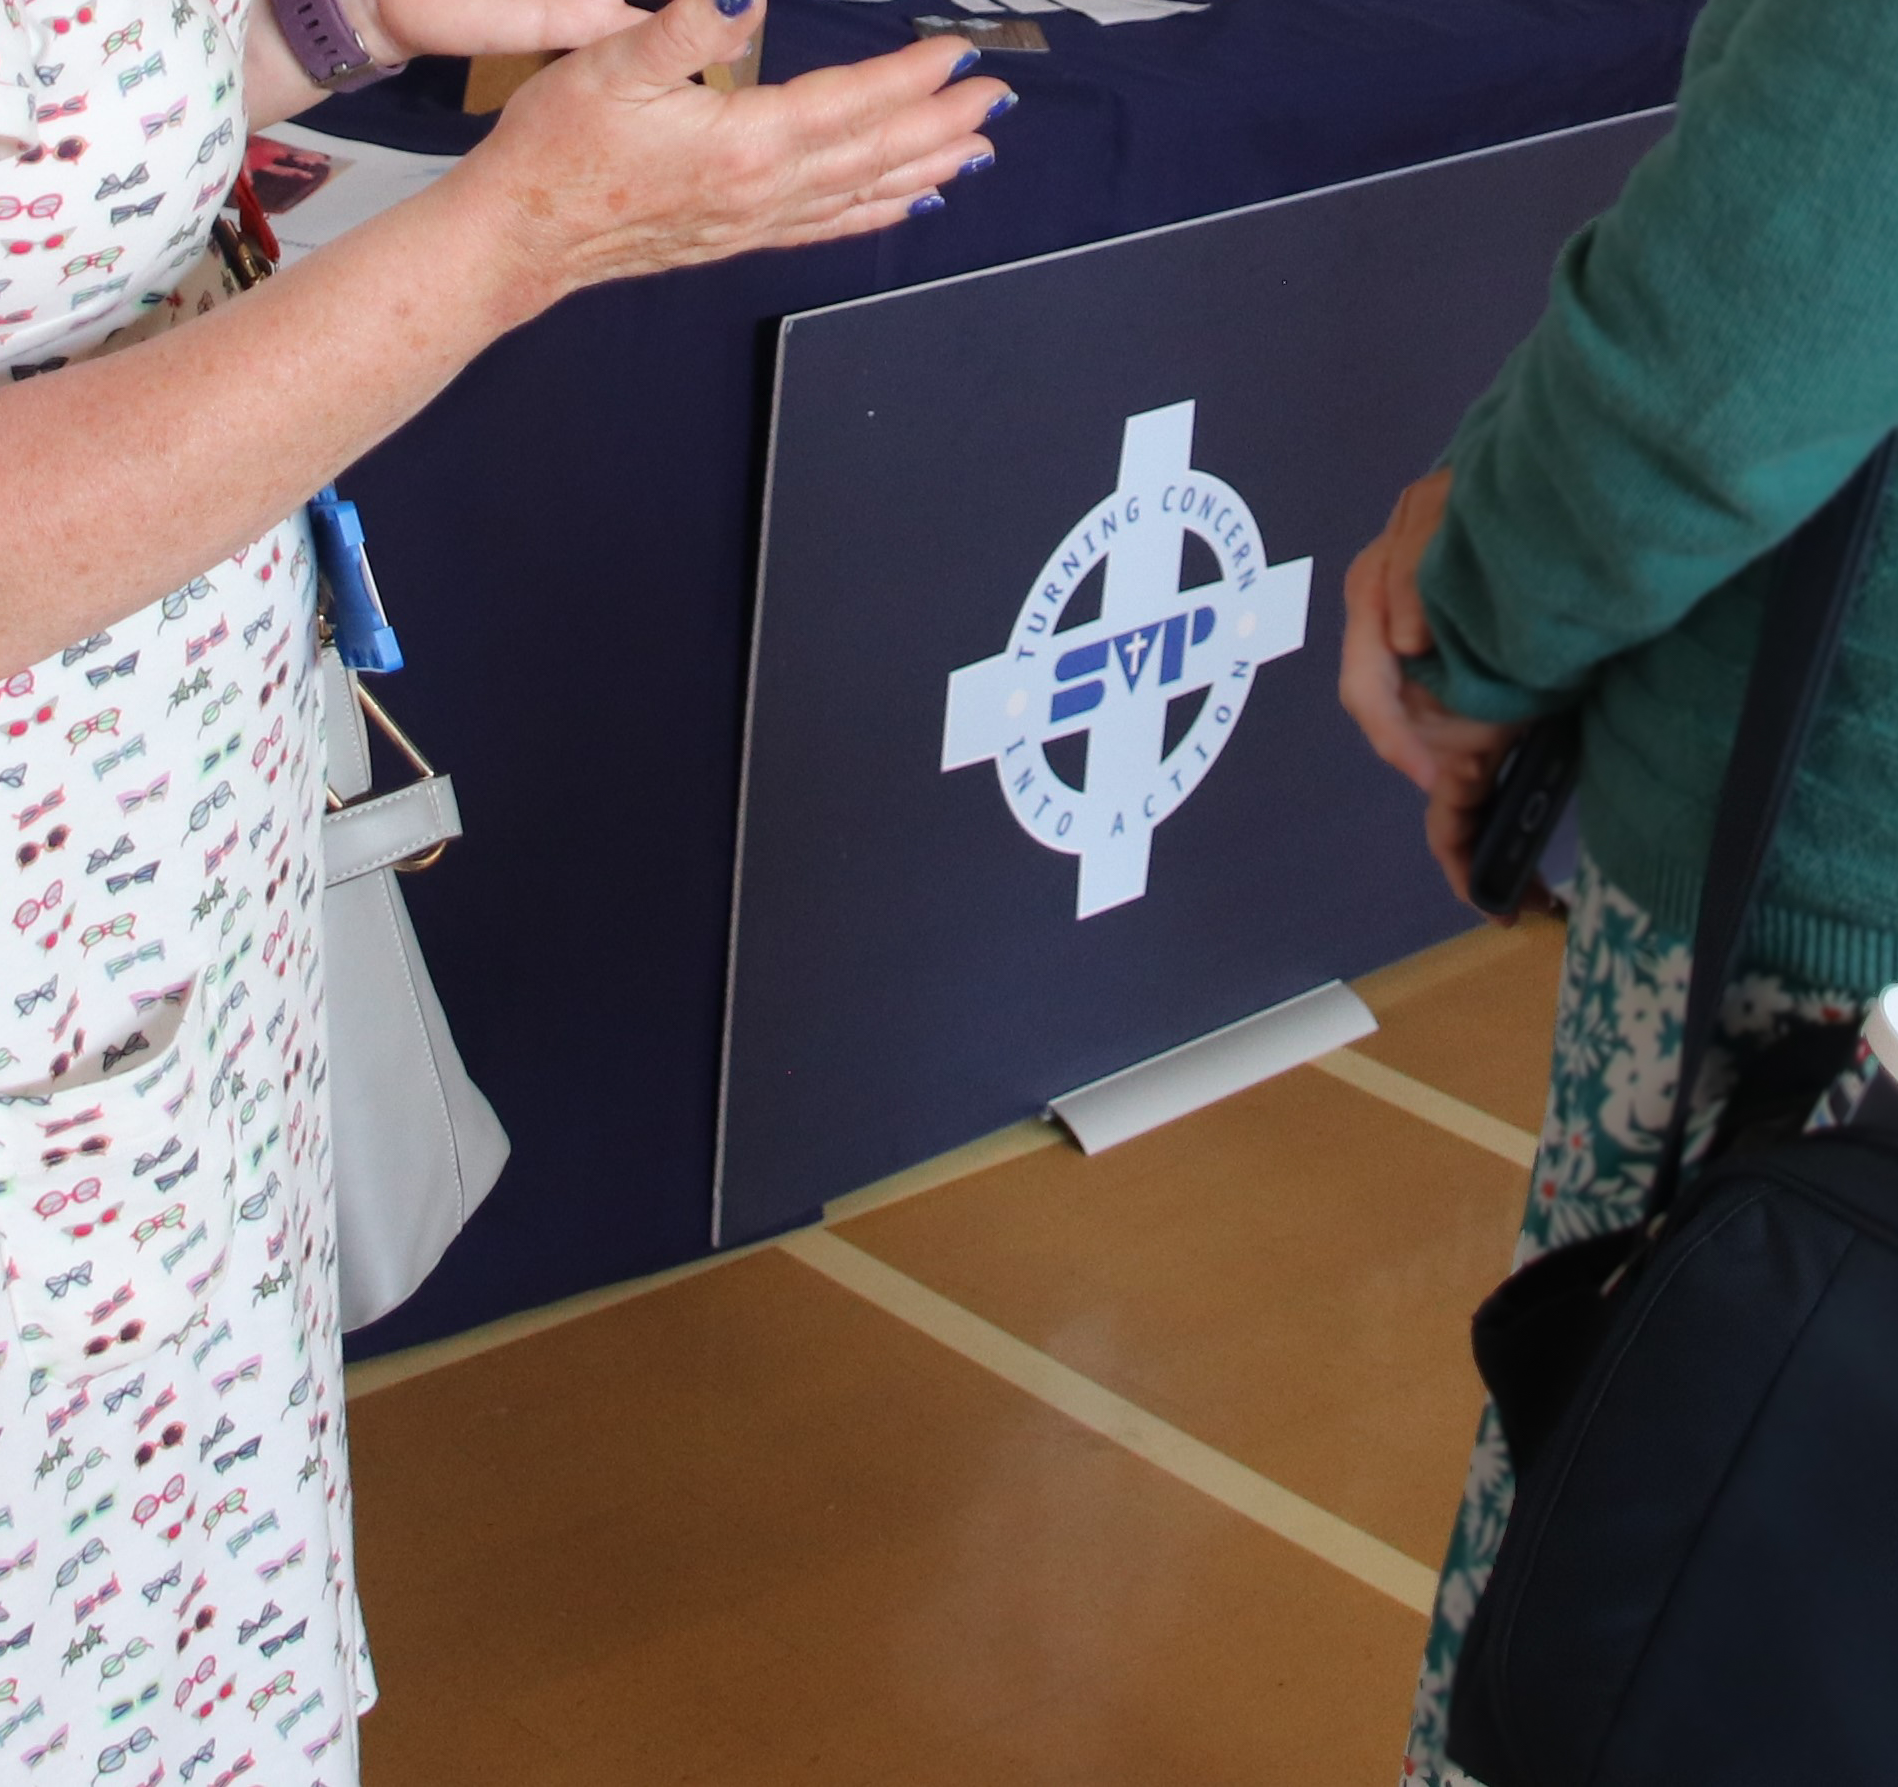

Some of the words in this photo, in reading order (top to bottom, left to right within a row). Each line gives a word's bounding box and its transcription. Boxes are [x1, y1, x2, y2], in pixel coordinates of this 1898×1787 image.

[1015, 495, 1141, 663] TURNING
[1161, 486, 1258, 593] CONCERN
[1005, 737, 1076, 839] INTO
[1109, 658, 1251, 838] ACTION
[1050, 605, 1216, 725] SVP
